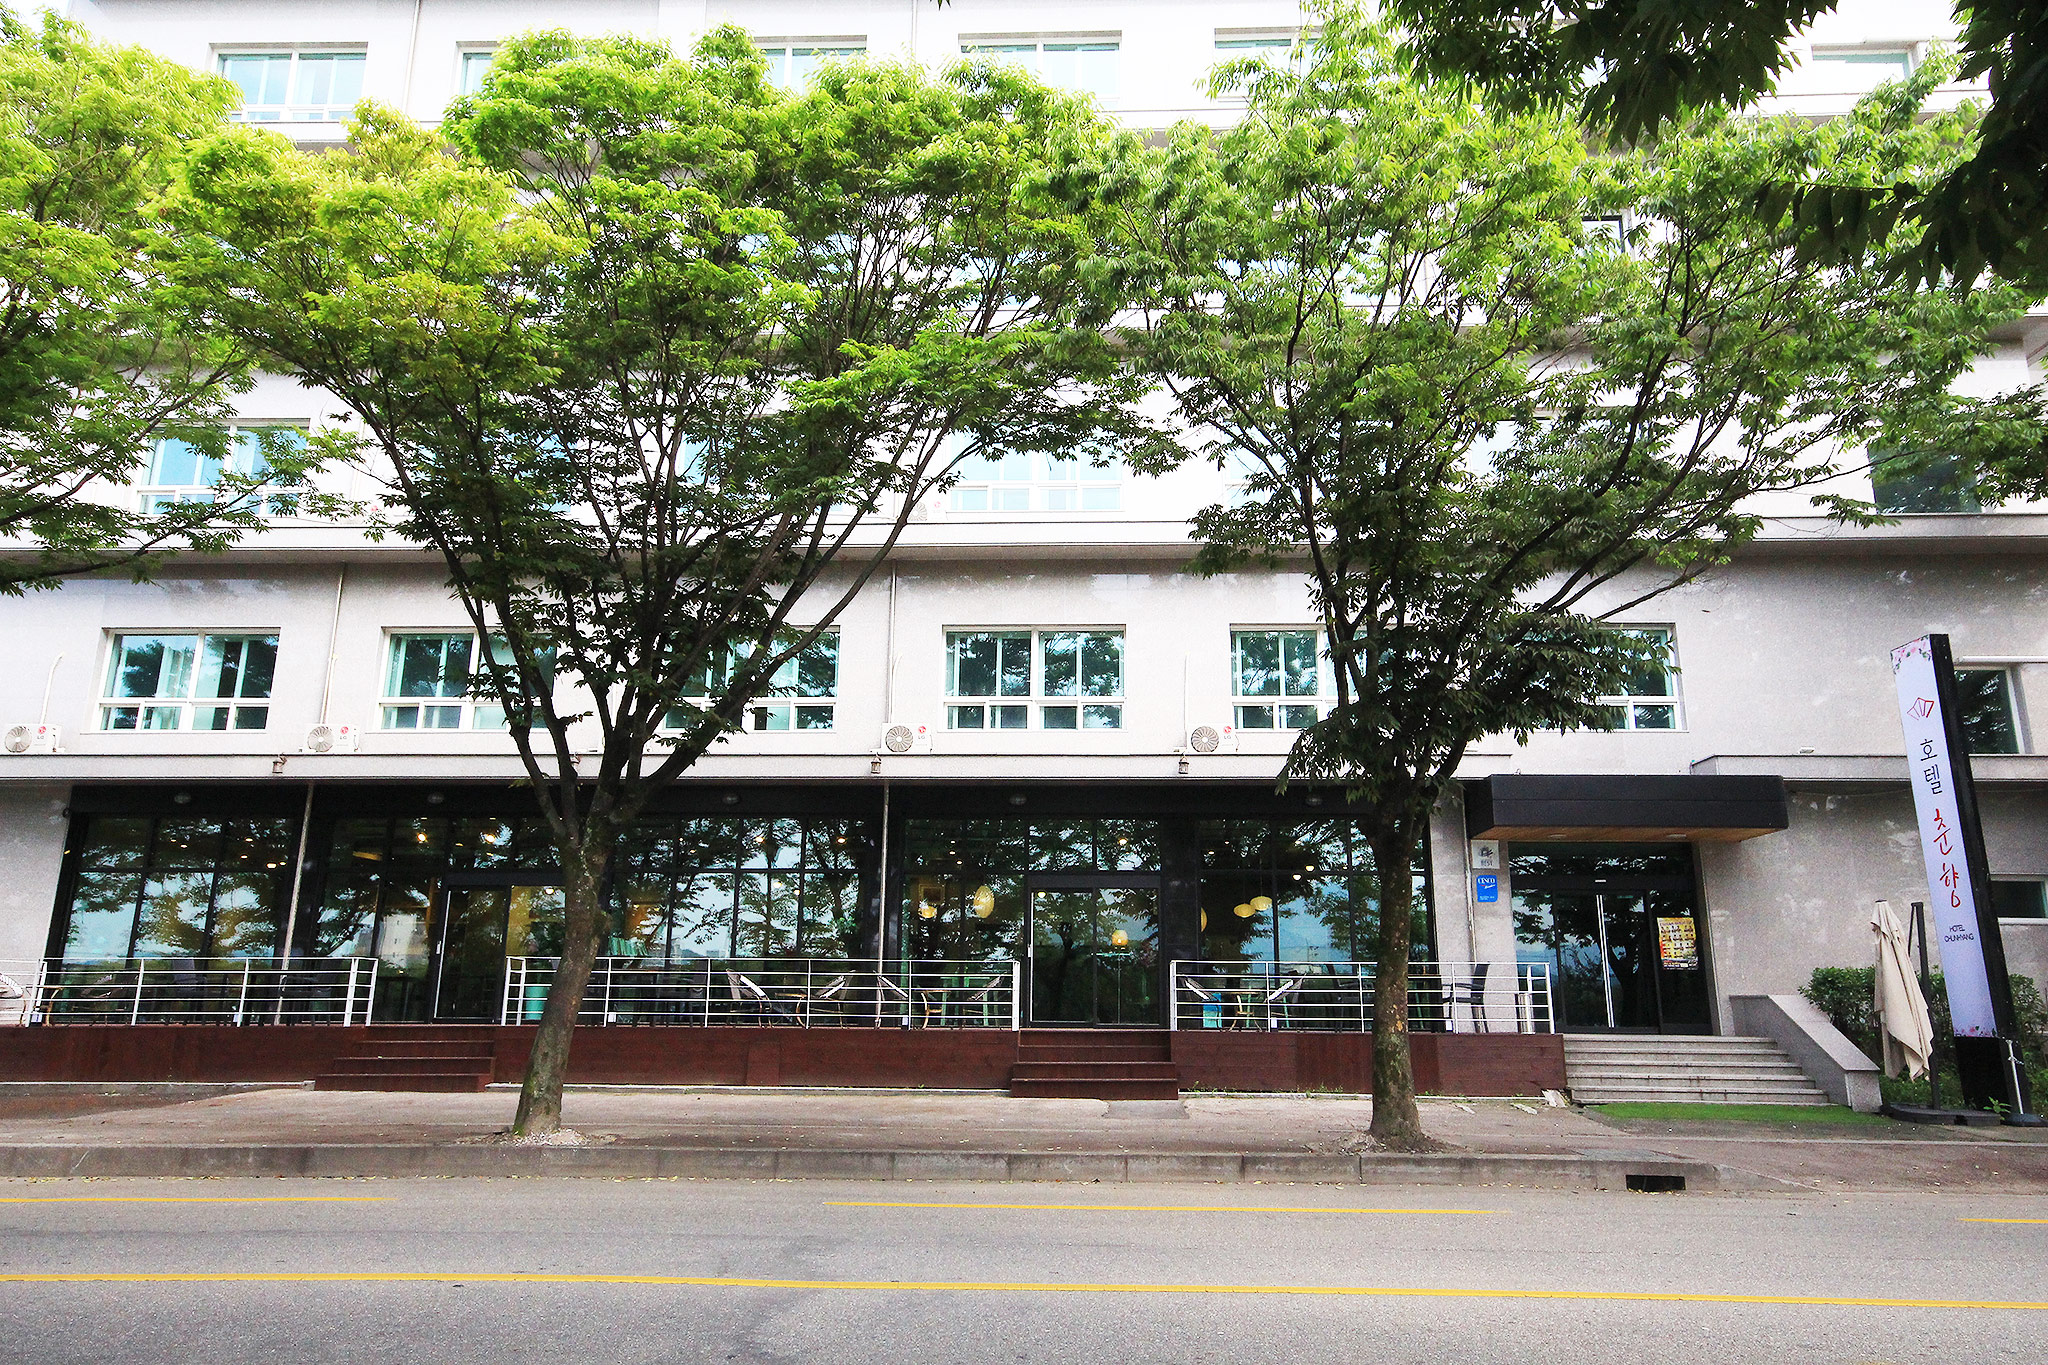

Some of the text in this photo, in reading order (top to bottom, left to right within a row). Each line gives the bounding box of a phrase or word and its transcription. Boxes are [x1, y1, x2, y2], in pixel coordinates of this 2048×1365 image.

[1919, 738, 1961, 908] 호텔 춘향
[1949, 924, 1965, 932] HOTEL
